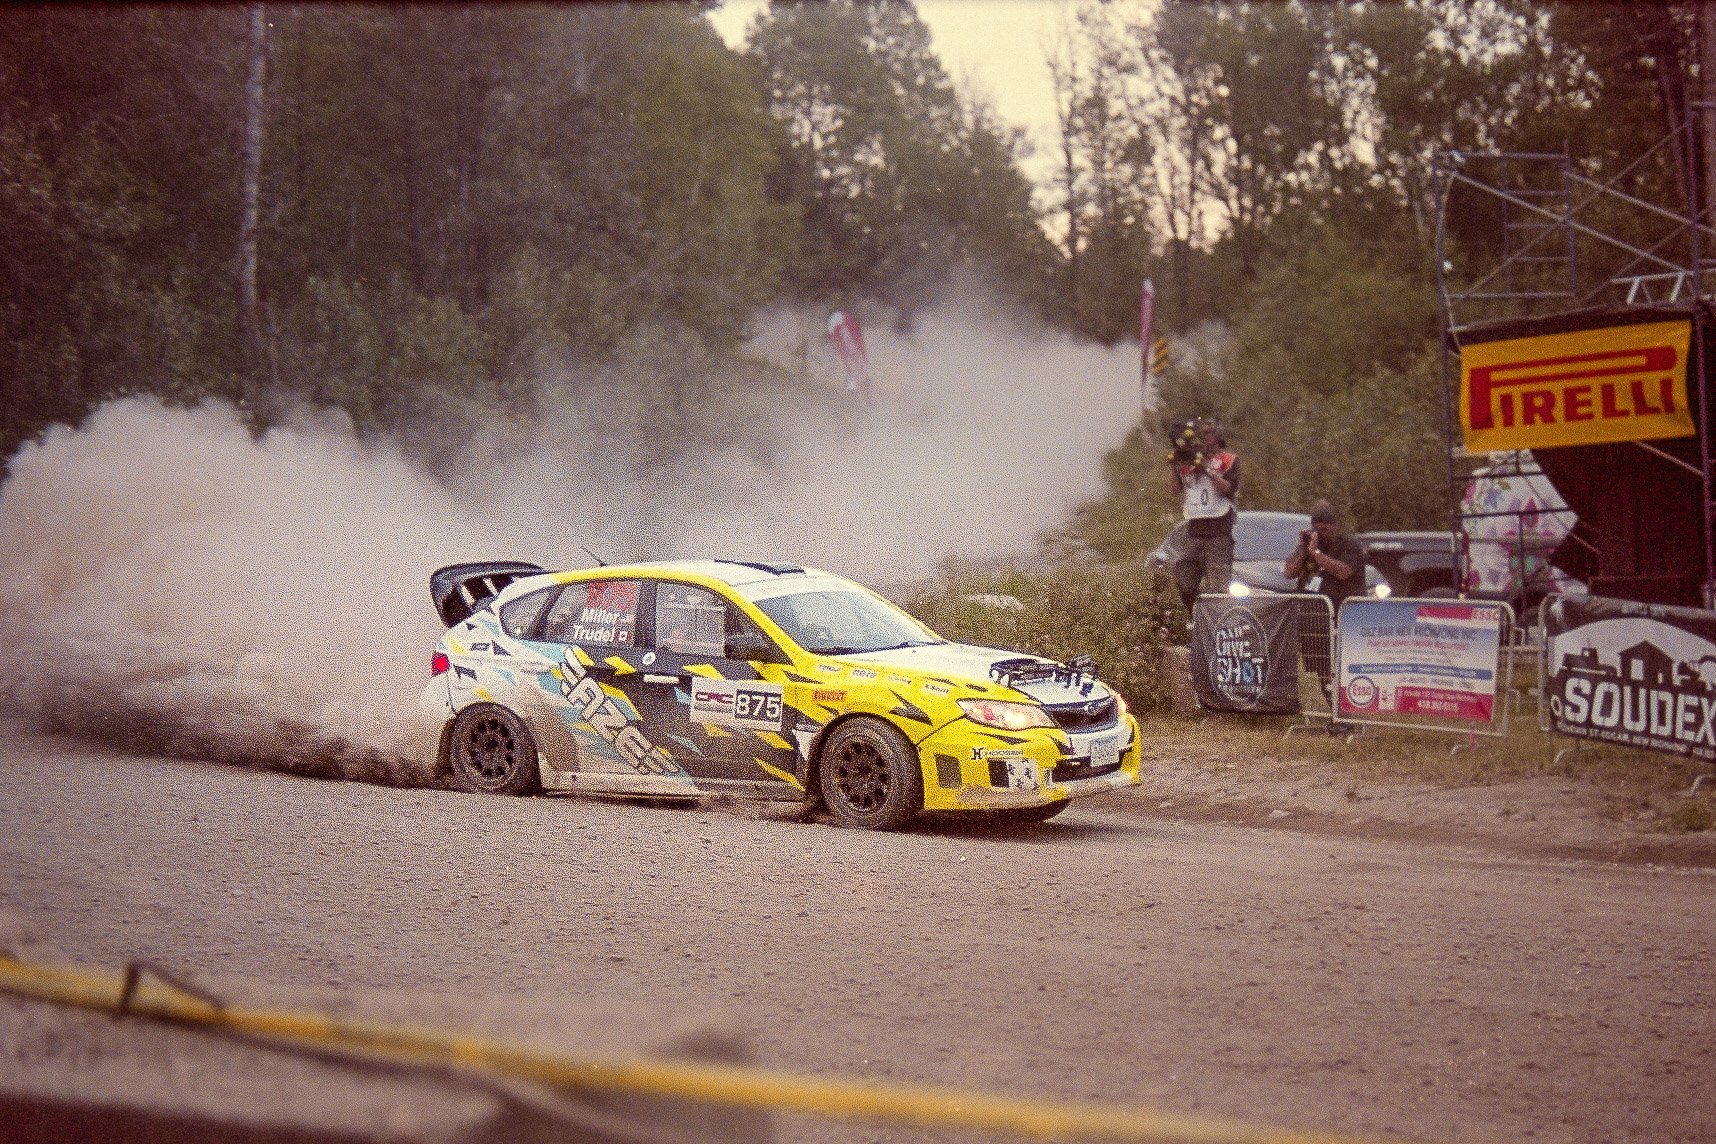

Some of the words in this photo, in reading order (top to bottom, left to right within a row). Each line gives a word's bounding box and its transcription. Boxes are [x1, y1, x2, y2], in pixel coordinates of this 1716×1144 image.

[1470, 345, 1677, 430] PIRELLI
[581, 608, 621, 623] Miller
[574, 624, 615, 642] Trudel
[736, 692, 780, 719] 875
[1564, 677, 1716, 746] SOUDEX
